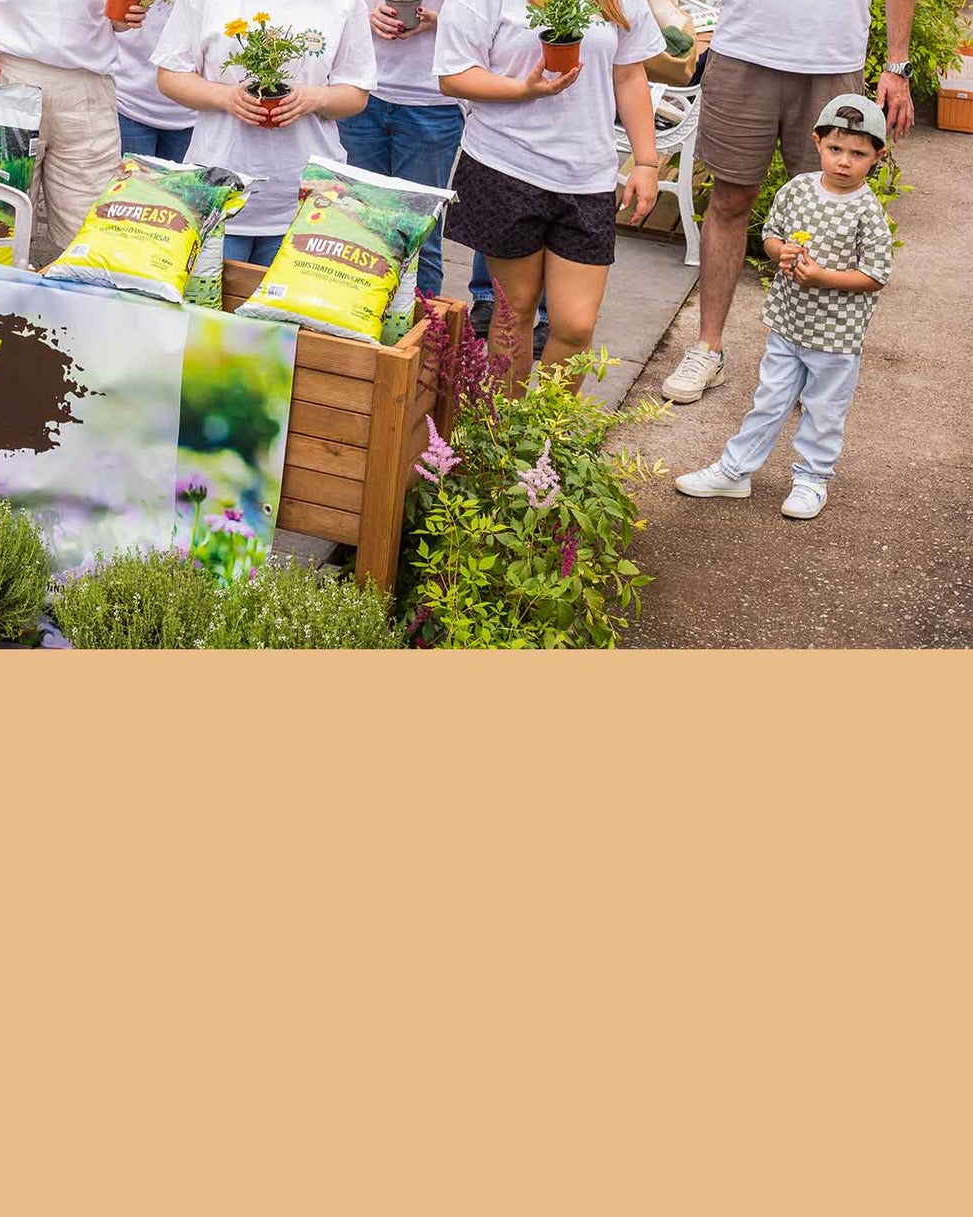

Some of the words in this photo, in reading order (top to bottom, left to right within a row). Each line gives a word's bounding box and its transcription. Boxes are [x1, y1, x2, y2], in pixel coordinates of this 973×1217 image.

[106, 203, 177, 224] NUTREASY
[305, 236, 379, 270] NUTREASY
[294, 259, 334, 274] SUBSTRATO
